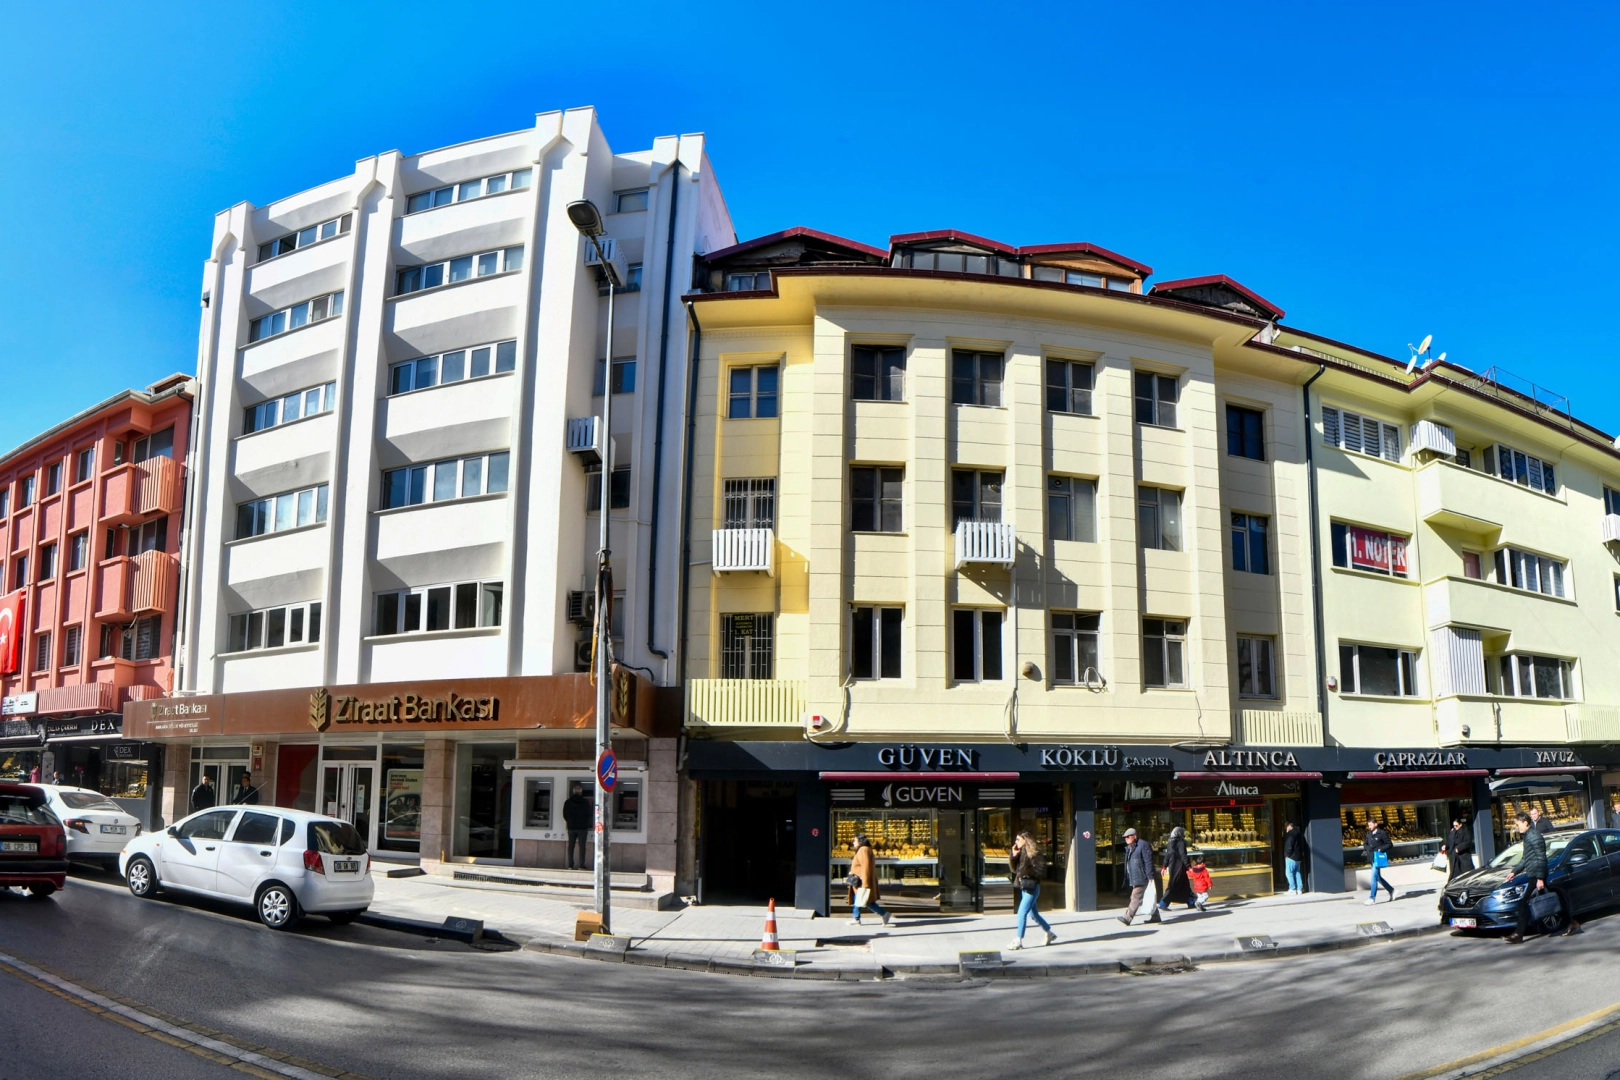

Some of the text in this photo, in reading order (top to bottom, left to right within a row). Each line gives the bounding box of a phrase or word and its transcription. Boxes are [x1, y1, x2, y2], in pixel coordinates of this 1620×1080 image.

[1364, 534, 1406, 567] NOTER
[335, 692, 495, 721] Ziraat Bankası
[91, 719, 116, 731] DEX
[878, 744, 974, 766] GÜVEN
[1040, 744, 1170, 768] KÖKLÜ ÇARŞISI
[1202, 750, 1298, 767] ALTINCA
[1374, 752, 1467, 770] ÇAPRAZLAR
[1535, 751, 1575, 763] YAVUZ
